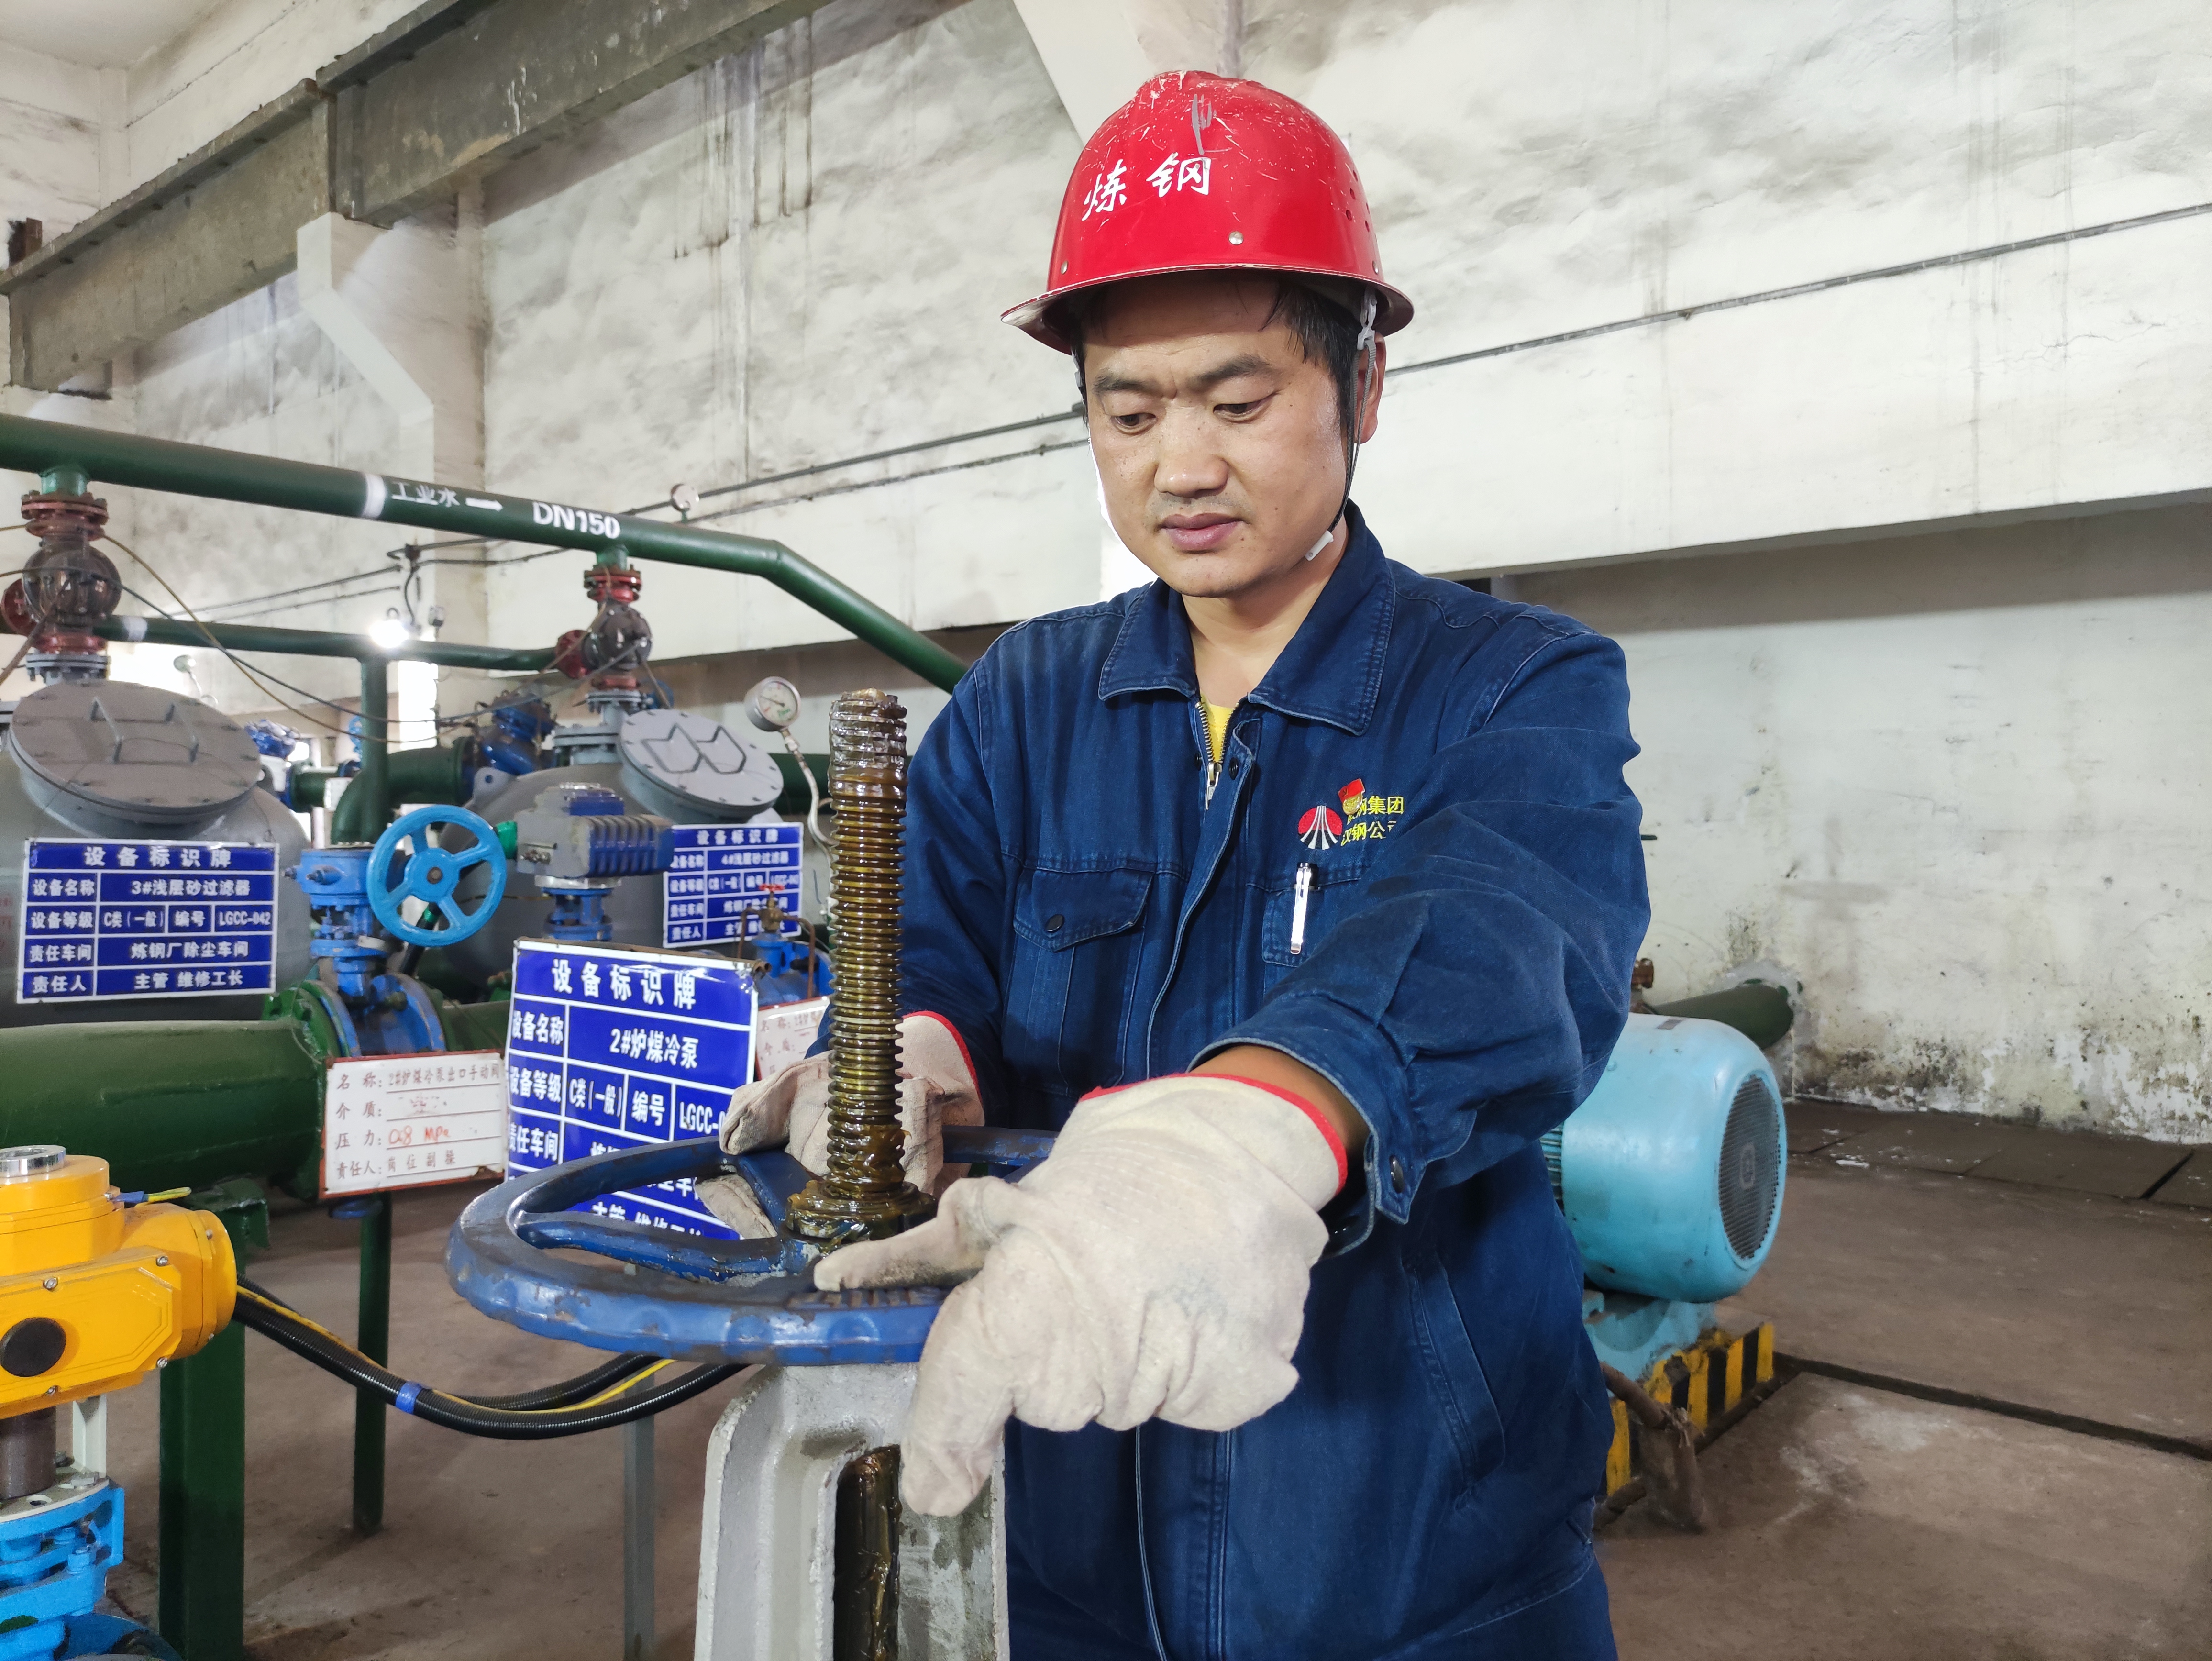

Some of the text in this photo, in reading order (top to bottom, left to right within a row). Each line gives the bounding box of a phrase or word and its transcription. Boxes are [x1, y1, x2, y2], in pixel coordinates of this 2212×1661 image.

[1081, 152, 1211, 221] 炼钢
[391, 482, 460, 508] 工业水
[533, 501, 620, 539] DN150
[1347, 795, 1404, 826] 集团
[84, 846, 231, 867] 设备标识牌
[33, 879, 95, 897] 设备名称
[131, 879, 250, 897] 3#浅层砂过滤器
[31, 911, 93, 929] 设备等级
[175, 911, 205, 927] 编号
[30, 944, 91, 963] 责任车间
[131, 941, 249, 960] 炼钢厂除尘车间
[32, 975, 87, 994] 责任人
[134, 970, 243, 990] 主管 维修工长
[553, 959, 696, 1010] 设备标识牌
[513, 1011, 564, 1045] 设备名称
[609, 1028, 698, 1069] 2#炉煤冷泵
[510, 1069, 562, 1103] 设备等级
[631, 1091, 665, 1126] 编号
